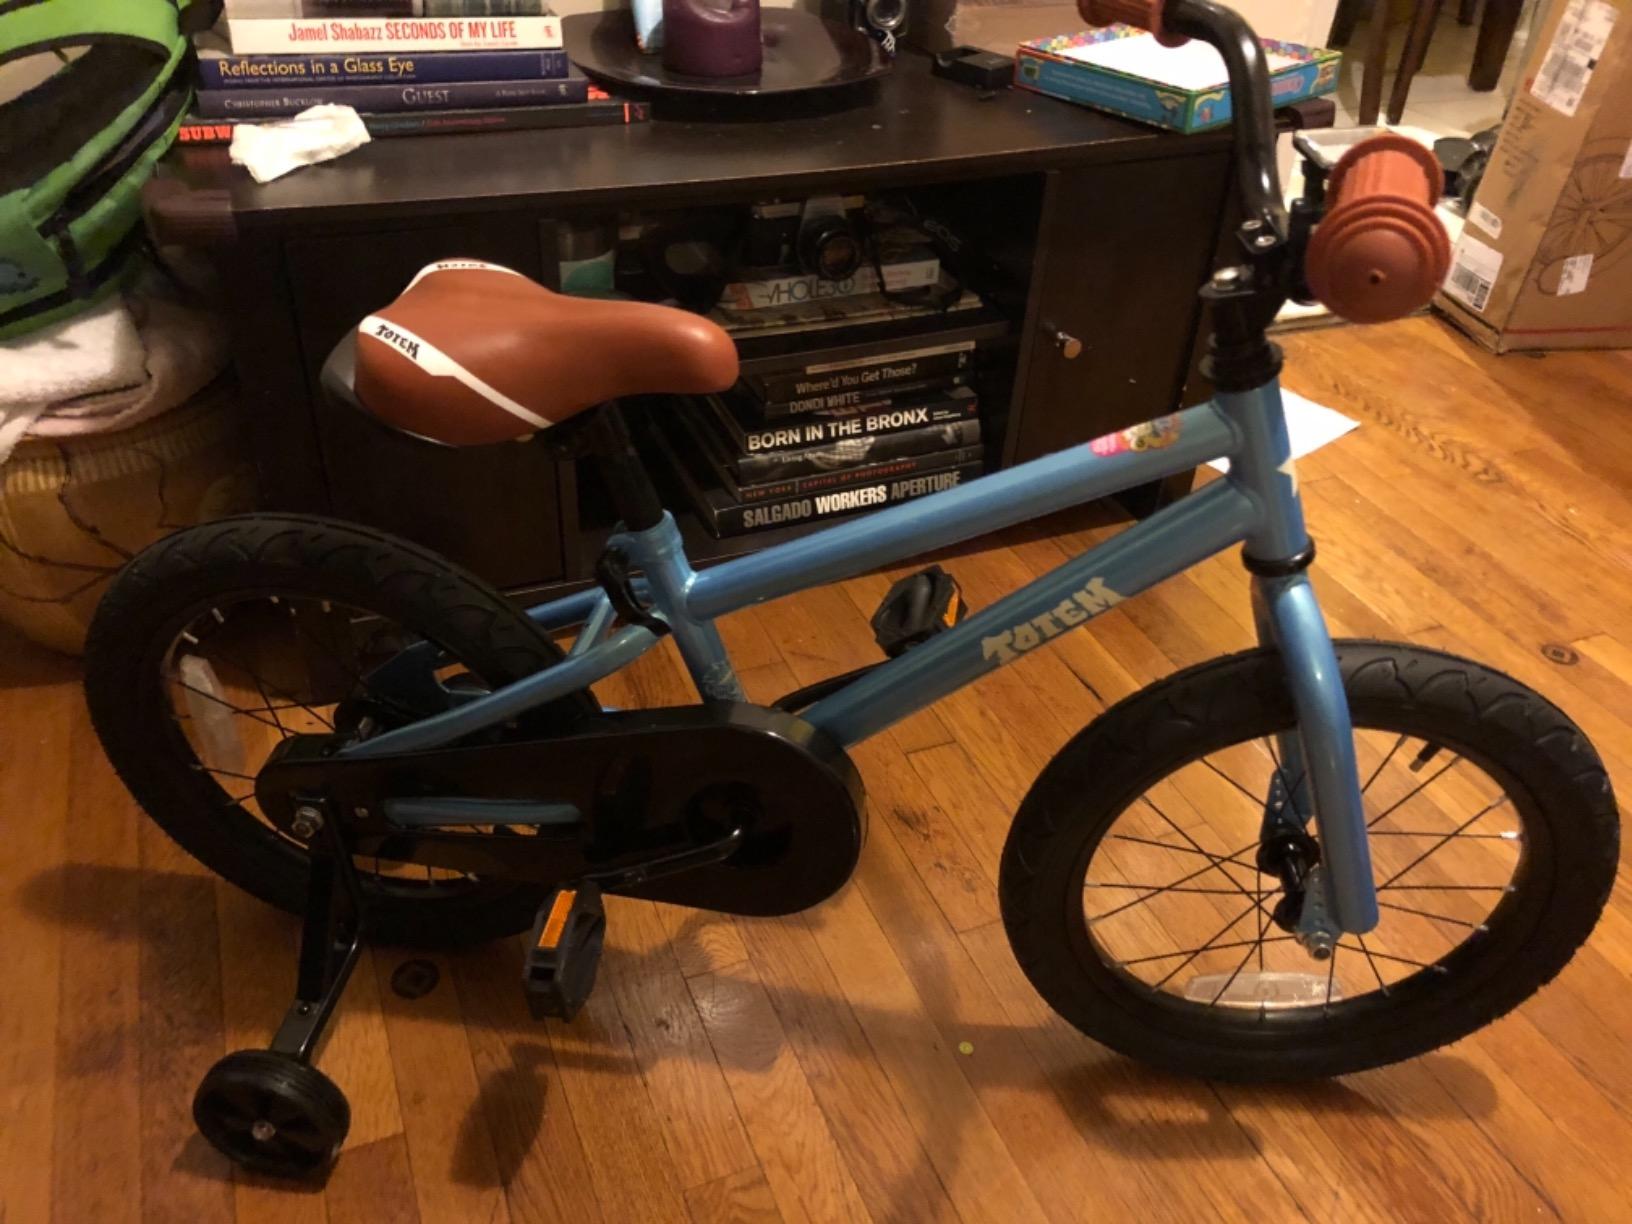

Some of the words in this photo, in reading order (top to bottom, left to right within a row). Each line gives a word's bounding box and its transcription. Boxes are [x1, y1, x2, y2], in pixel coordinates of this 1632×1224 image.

[288, 22, 328, 42] Jamel
[331, 21, 383, 42] Shabazz
[385, 21, 445, 40] SECONDS
[449, 21, 465, 39] OF
[468, 21, 488, 39] MY
[491, 20, 517, 38] LIFE
[219, 57, 305, 76] Reflections
[311, 59, 326, 75] in
[330, 63, 339, 74] a
[344, 57, 384, 74] Glass
[388, 57, 415, 77] Eye
[402, 87, 451, 104] GUEST
[179, 124, 232, 141] SUBW
[375, 324, 420, 360] TOTEM
[841, 373, 860, 387] You
[861, 369, 880, 383] Get
[881, 362, 917, 379] Those?
[826, 391, 861, 407] WHITE
[748, 429, 801, 451] BORN
[805, 424, 824, 441] IN
[827, 418, 862, 438] THE
[866, 407, 929, 432] BRONX
[743, 500, 812, 528] SALGADO
[815, 485, 887, 515] WORKERS
[890, 470, 960, 498] APERTURE
[981, 576, 1130, 663] TOTEM
